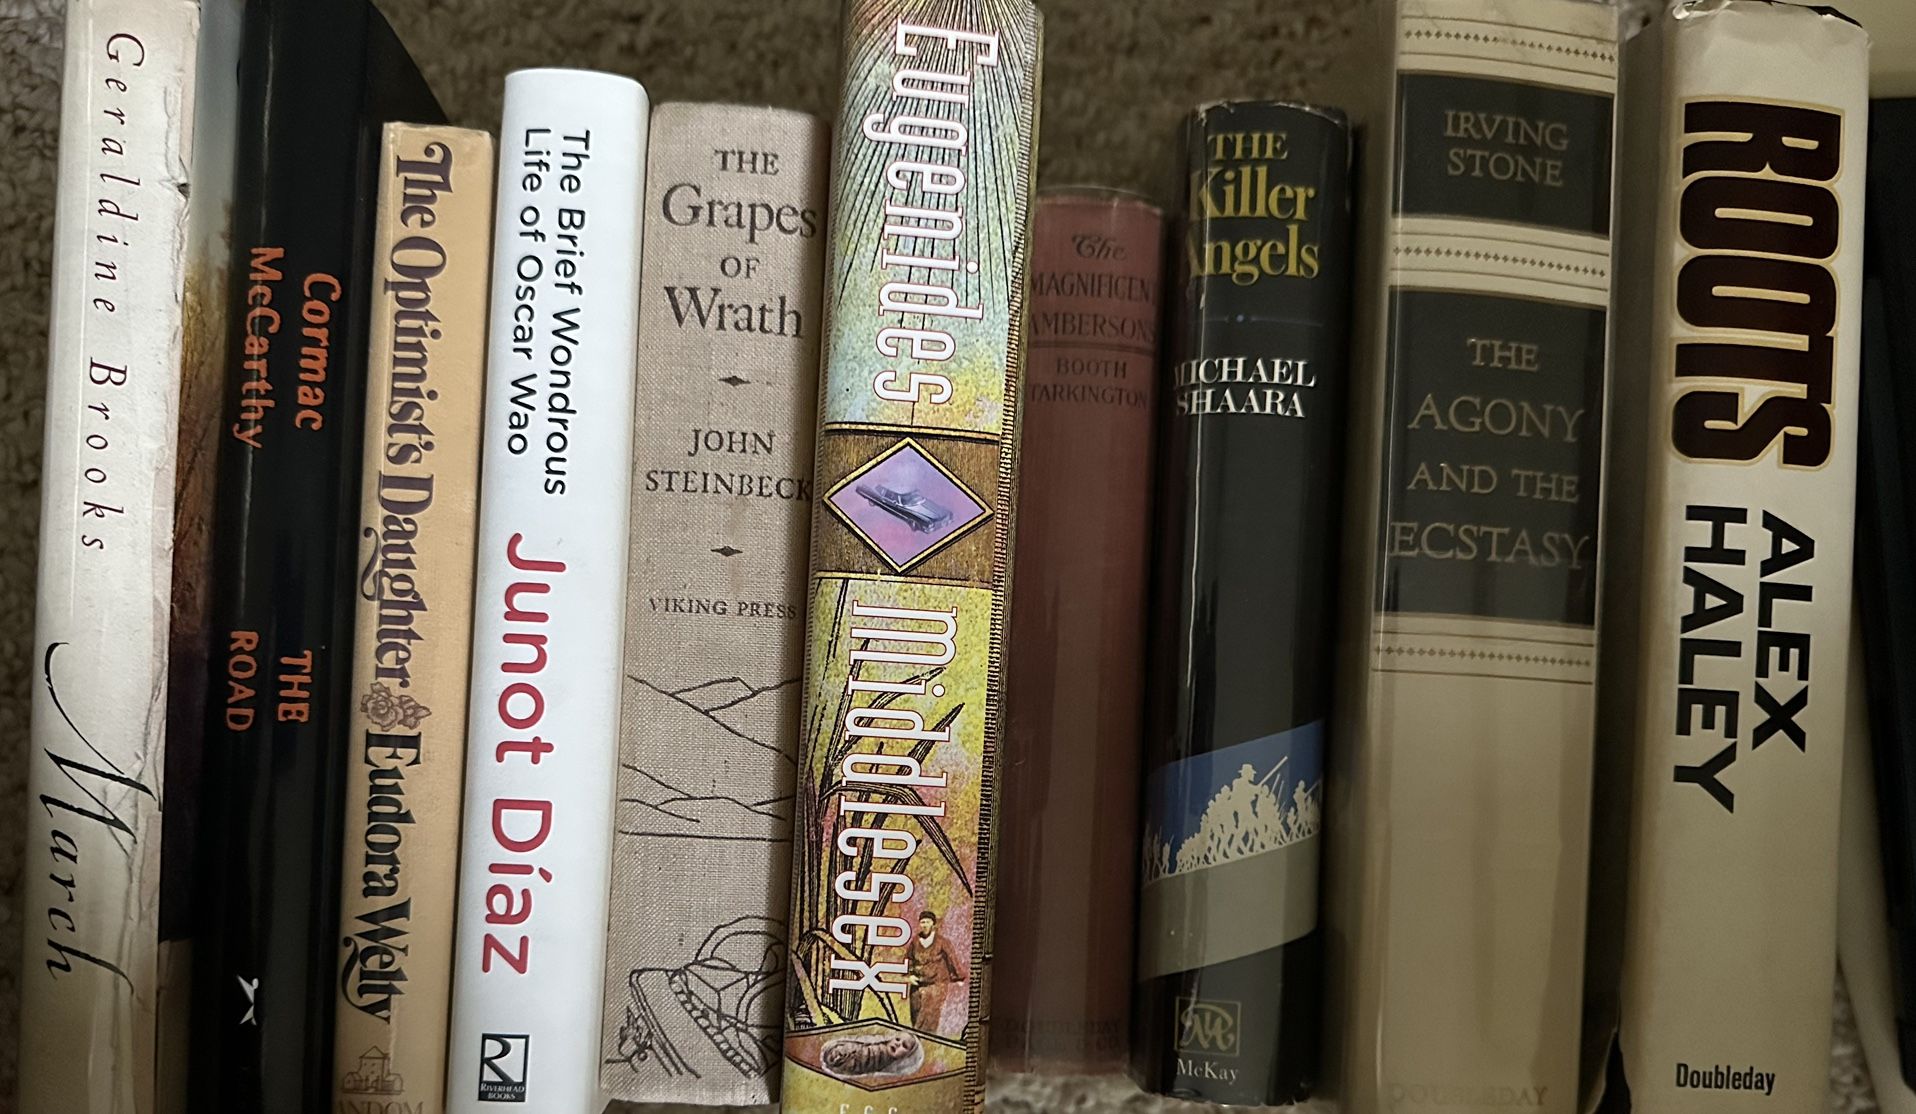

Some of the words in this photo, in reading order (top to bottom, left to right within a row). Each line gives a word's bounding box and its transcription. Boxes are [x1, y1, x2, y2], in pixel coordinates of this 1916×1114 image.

[520, 128, 552, 194] Life
[557, 129, 591, 195] The
[714, 149, 779, 175] THE
[1207, 132, 1288, 161] THE
[1444, 110, 1569, 151] IRVING
[92, 32, 145, 314] Geraldine
[395, 141, 453, 228] The
[1189, 164, 1317, 221] Killer
[1447, 149, 1564, 187] STONE
[518, 205, 546, 244] of
[662, 183, 817, 244] Grapes
[862, 20, 1000, 406] Eugenides
[551, 207, 586, 299] Brief
[720, 256, 761, 279] OF
[1072, 233, 1128, 261] The
[511, 253, 543, 360] Oscar
[663, 286, 802, 339] Wrath
[1031, 270, 1151, 303] MAGNIFICEN
[1670, 98, 1844, 470] ROOTS
[233, 246, 285, 448] McCarthy
[295, 272, 342, 431] Cormac
[383, 235, 447, 466] Optimist's
[1056, 357, 1127, 379] BOOTH
[1467, 338, 1540, 372] THE
[506, 373, 540, 456] Wao
[543, 308, 583, 496] Wondrous
[1176, 387, 1306, 419] SHAARA
[1407, 394, 1585, 443] AGONY
[81, 356, 127, 551] Brooks
[688, 428, 776, 457] JOHN
[645, 469, 812, 501] STEINBECK
[1407, 463, 1498, 495] AND
[1511, 469, 1580, 503] THE
[1388, 522, 1591, 570] ECSTASY
[360, 472, 435, 688] Daughter
[649, 598, 729, 616] VIKING
[737, 601, 797, 619] PRESS
[494, 531, 567, 764] Junot
[1673, 505, 1748, 814] HALEY
[1752, 509, 1815, 753] ALEX
[227, 630, 260, 732] ROAD
[277, 650, 313, 723] THE
[39, 641, 157, 995] March
[362, 729, 423, 898] Eudora
[481, 797, 554, 975] Díaz
[341, 897, 412, 1025] Welty
[1177, 1058, 1239, 1086] McKay
[1676, 1062, 1776, 1096] Doubleday
